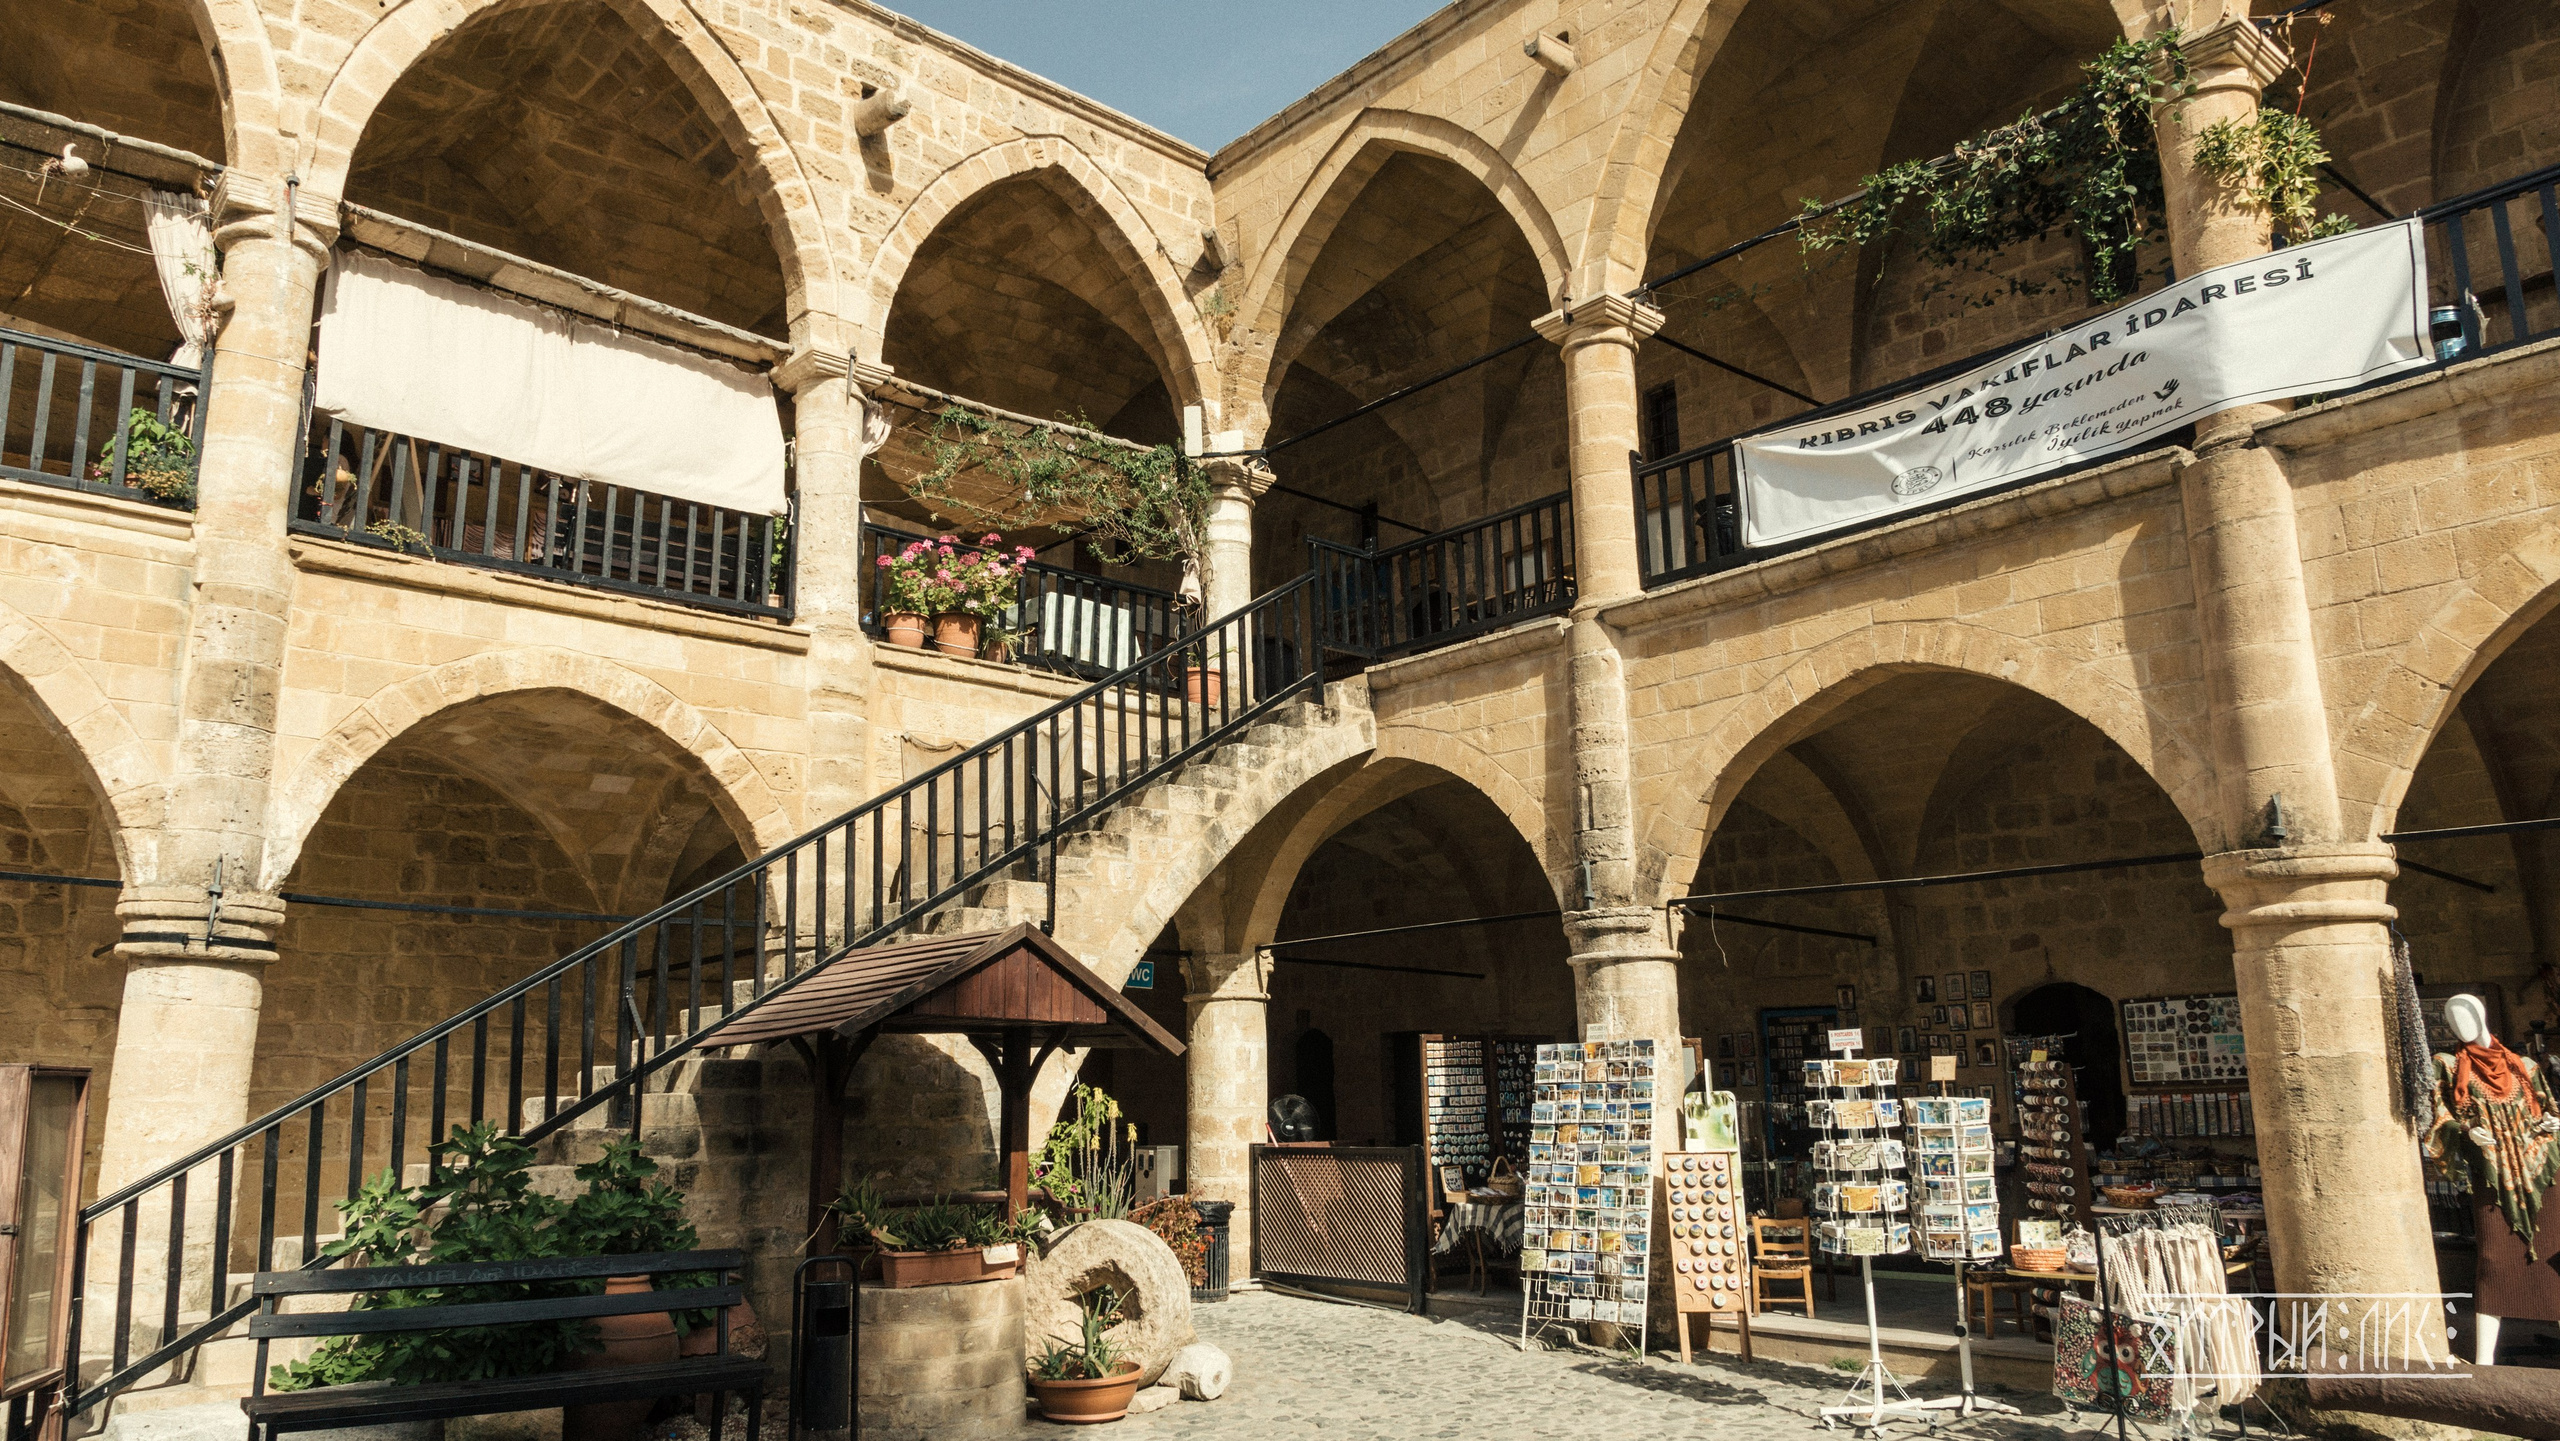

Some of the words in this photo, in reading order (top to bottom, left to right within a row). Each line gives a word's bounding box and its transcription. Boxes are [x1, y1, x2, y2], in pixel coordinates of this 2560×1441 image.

[1799, 410, 1917, 450] KIBRIS
[1927, 330, 2112, 411] VAKIFLAR
[2126, 257, 2315, 337] İDARESİ
[1920, 396, 2013, 436] 448
[2018, 350, 2151, 416] yaşında
[1968, 430, 2037, 460] Karşılık
[2044, 394, 2147, 436] Beklemeden
[2047, 420, 2112, 452] İyilik
[2115, 397, 2184, 434] Yapmak
[1131, 968, 1150, 982] WC
[368, 1265, 502, 1288] VAKIFLAR
